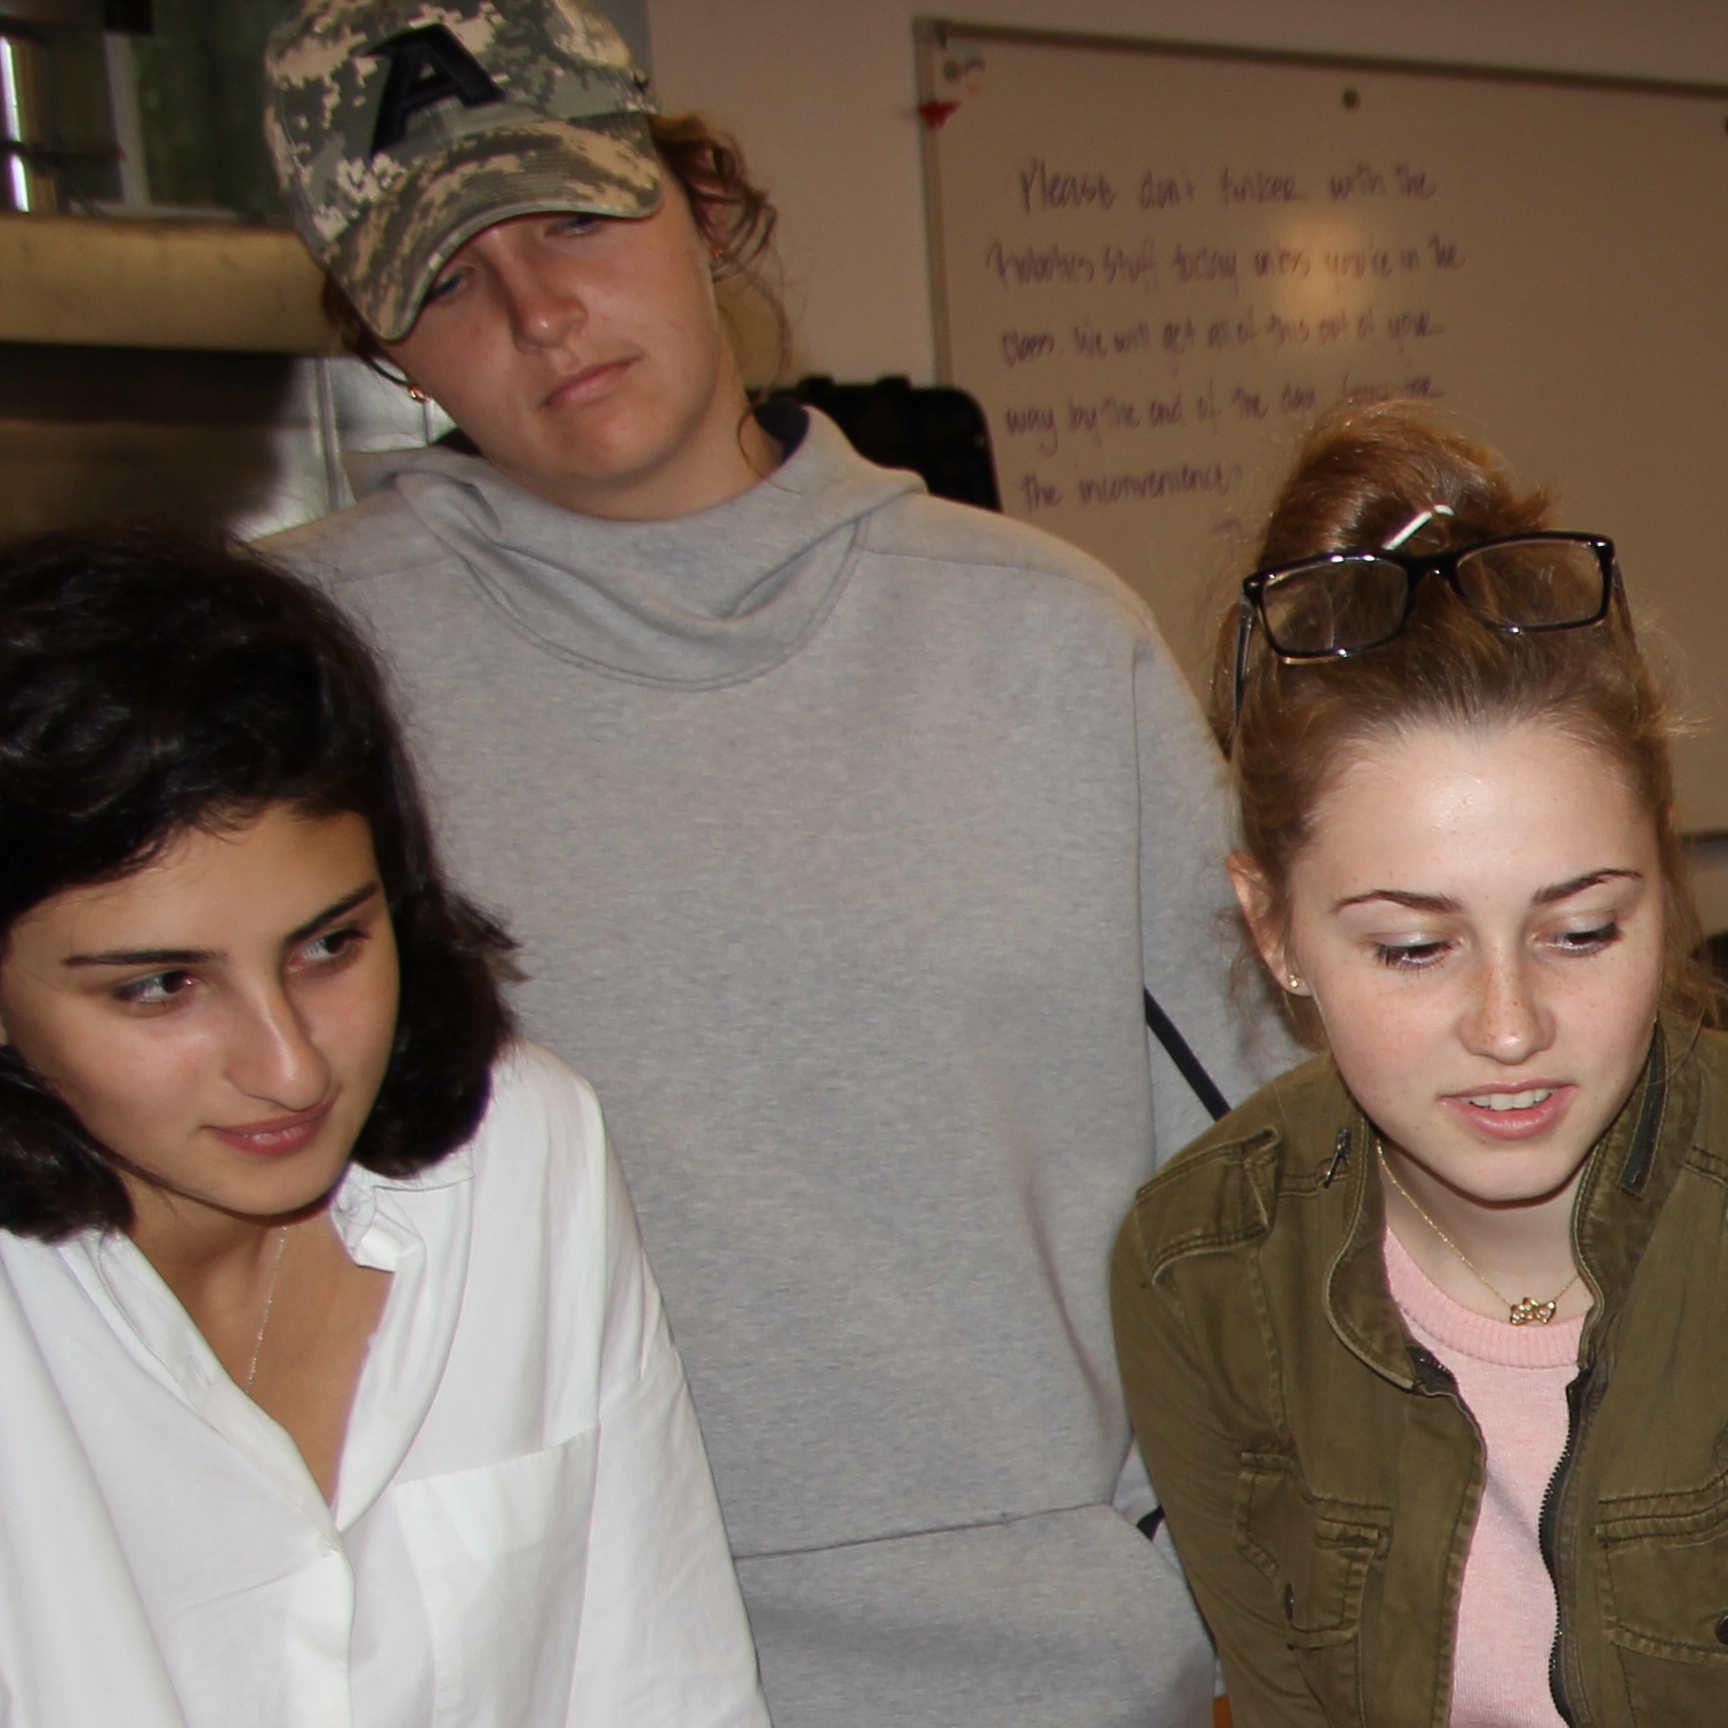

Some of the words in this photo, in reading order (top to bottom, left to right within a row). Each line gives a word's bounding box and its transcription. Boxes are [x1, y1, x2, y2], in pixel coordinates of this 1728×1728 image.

[360, 22, 505, 156] A
[1020, 156, 1117, 214] Please
[1330, 161, 1387, 200] with
[1005, 405, 1059, 457] way
[1068, 397, 1102, 449] by
[1149, 391, 1186, 428] end
